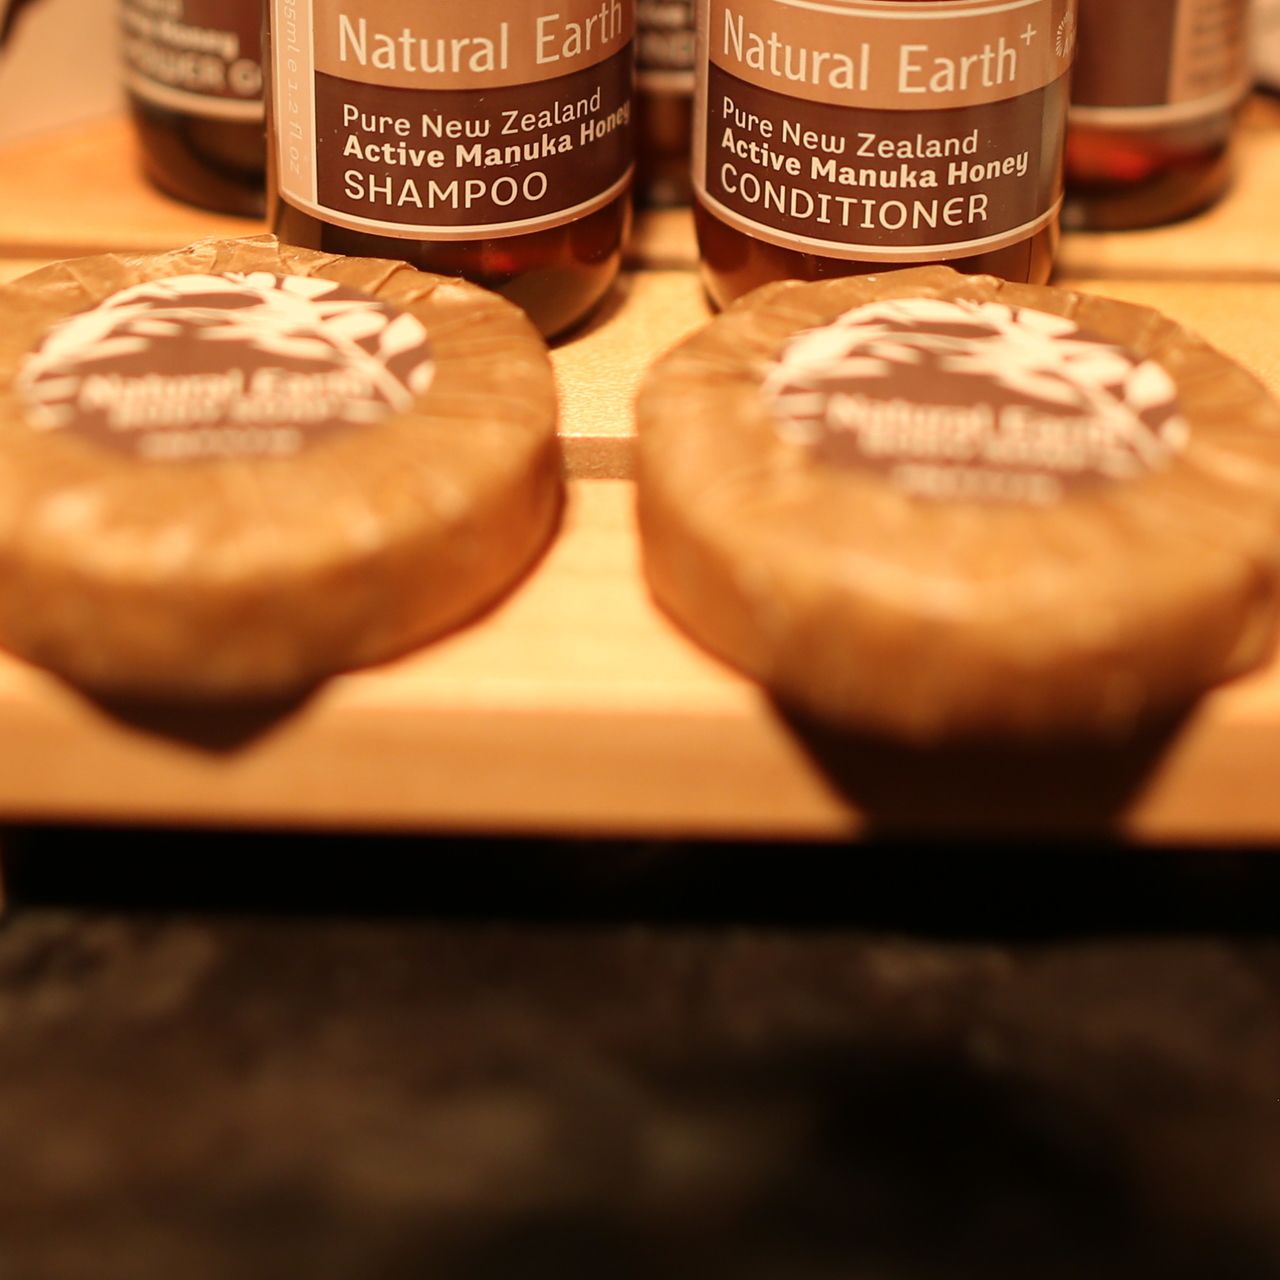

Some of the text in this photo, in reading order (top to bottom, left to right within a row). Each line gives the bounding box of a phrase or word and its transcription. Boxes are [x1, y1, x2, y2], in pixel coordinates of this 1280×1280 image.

[338, 14, 508, 73] Natural
[723, 8, 869, 91] Natural
[343, 86, 601, 138] Pure New Zealand
[343, 100, 630, 168] Active Manuka Honey
[723, 96, 978, 159] Pure New Zealand
[343, 170, 548, 208] SHAMPOO
[722, 132, 1028, 188] Active Manuka Honey
[721, 165, 987, 229] CONDITIONER
